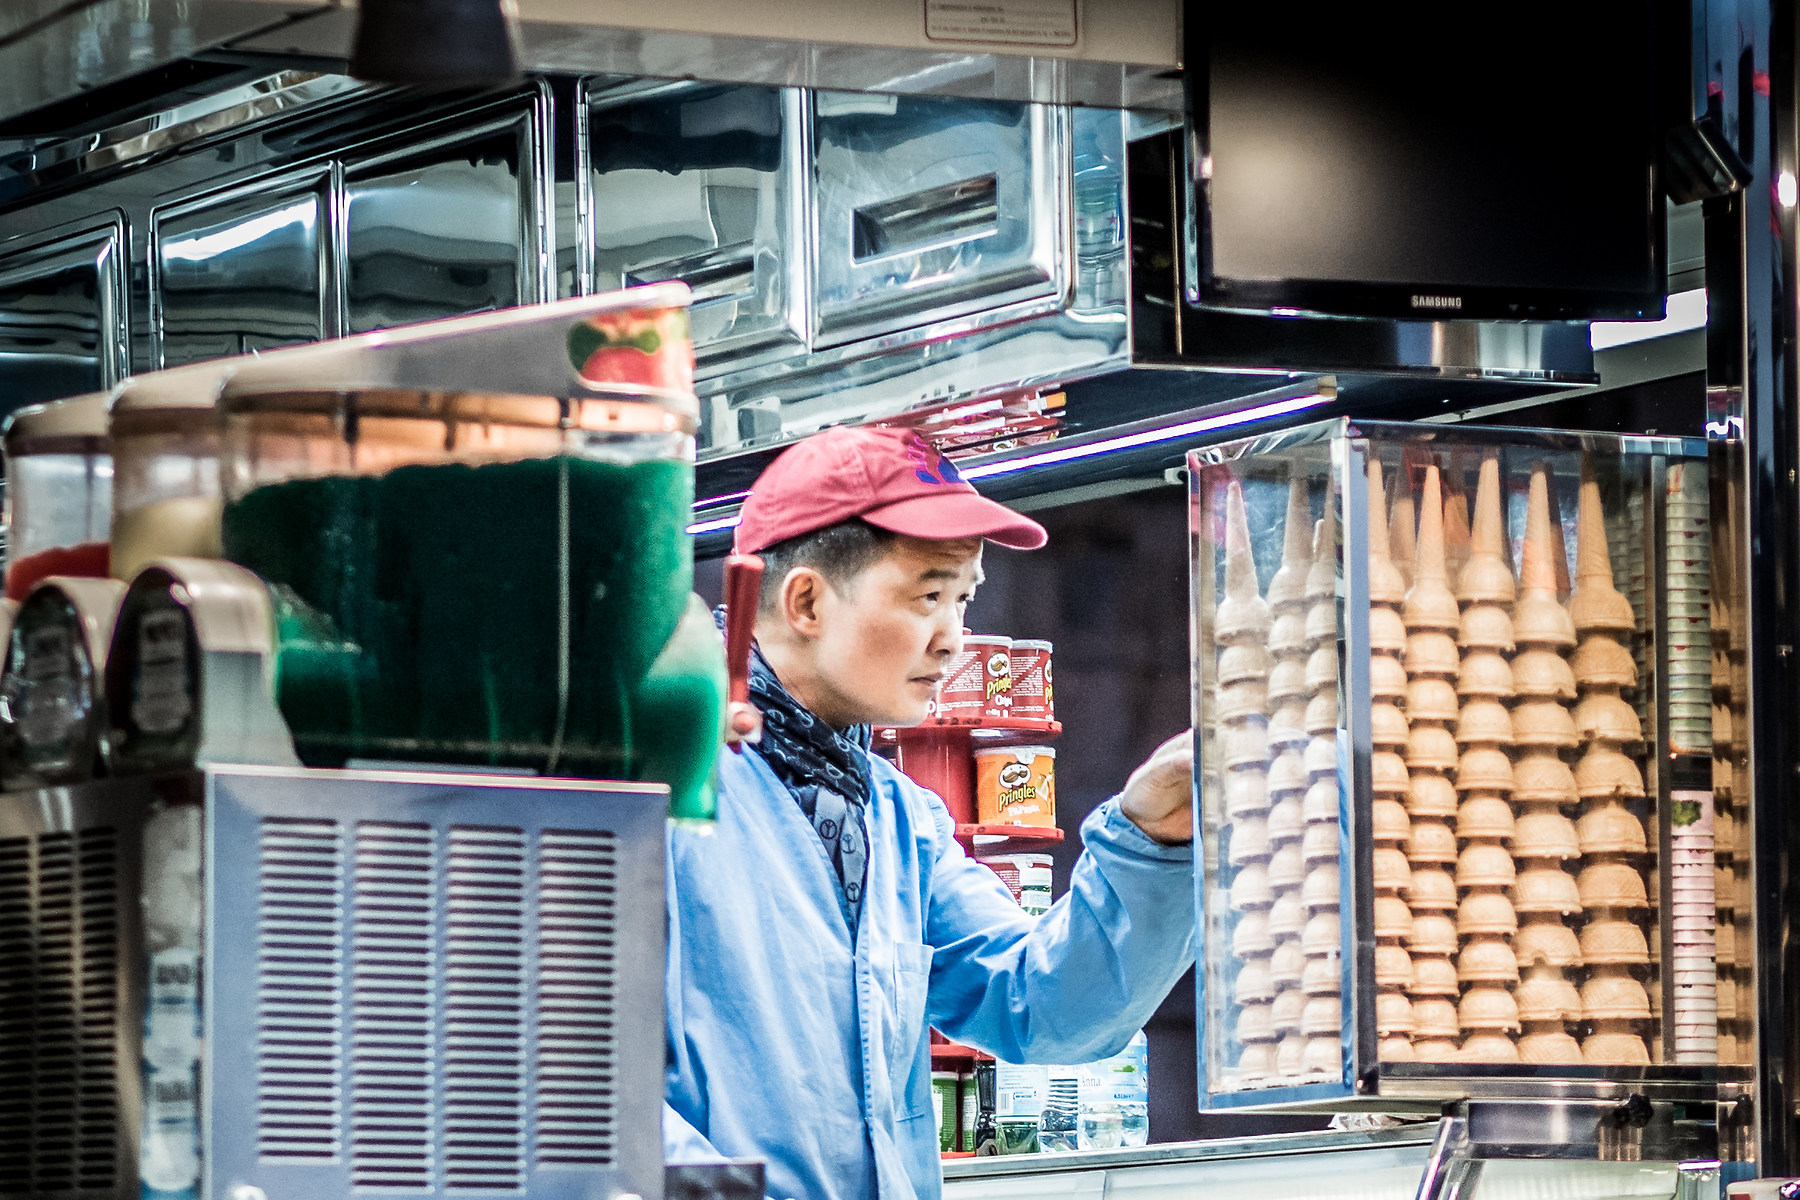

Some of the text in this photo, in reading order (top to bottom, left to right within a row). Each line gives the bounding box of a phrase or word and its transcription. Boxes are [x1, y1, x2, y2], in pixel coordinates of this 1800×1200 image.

[1411, 294, 1462, 309] SAMSUNG
[986, 674, 1012, 701] Pringle
[998, 783, 1037, 813] Pringles
